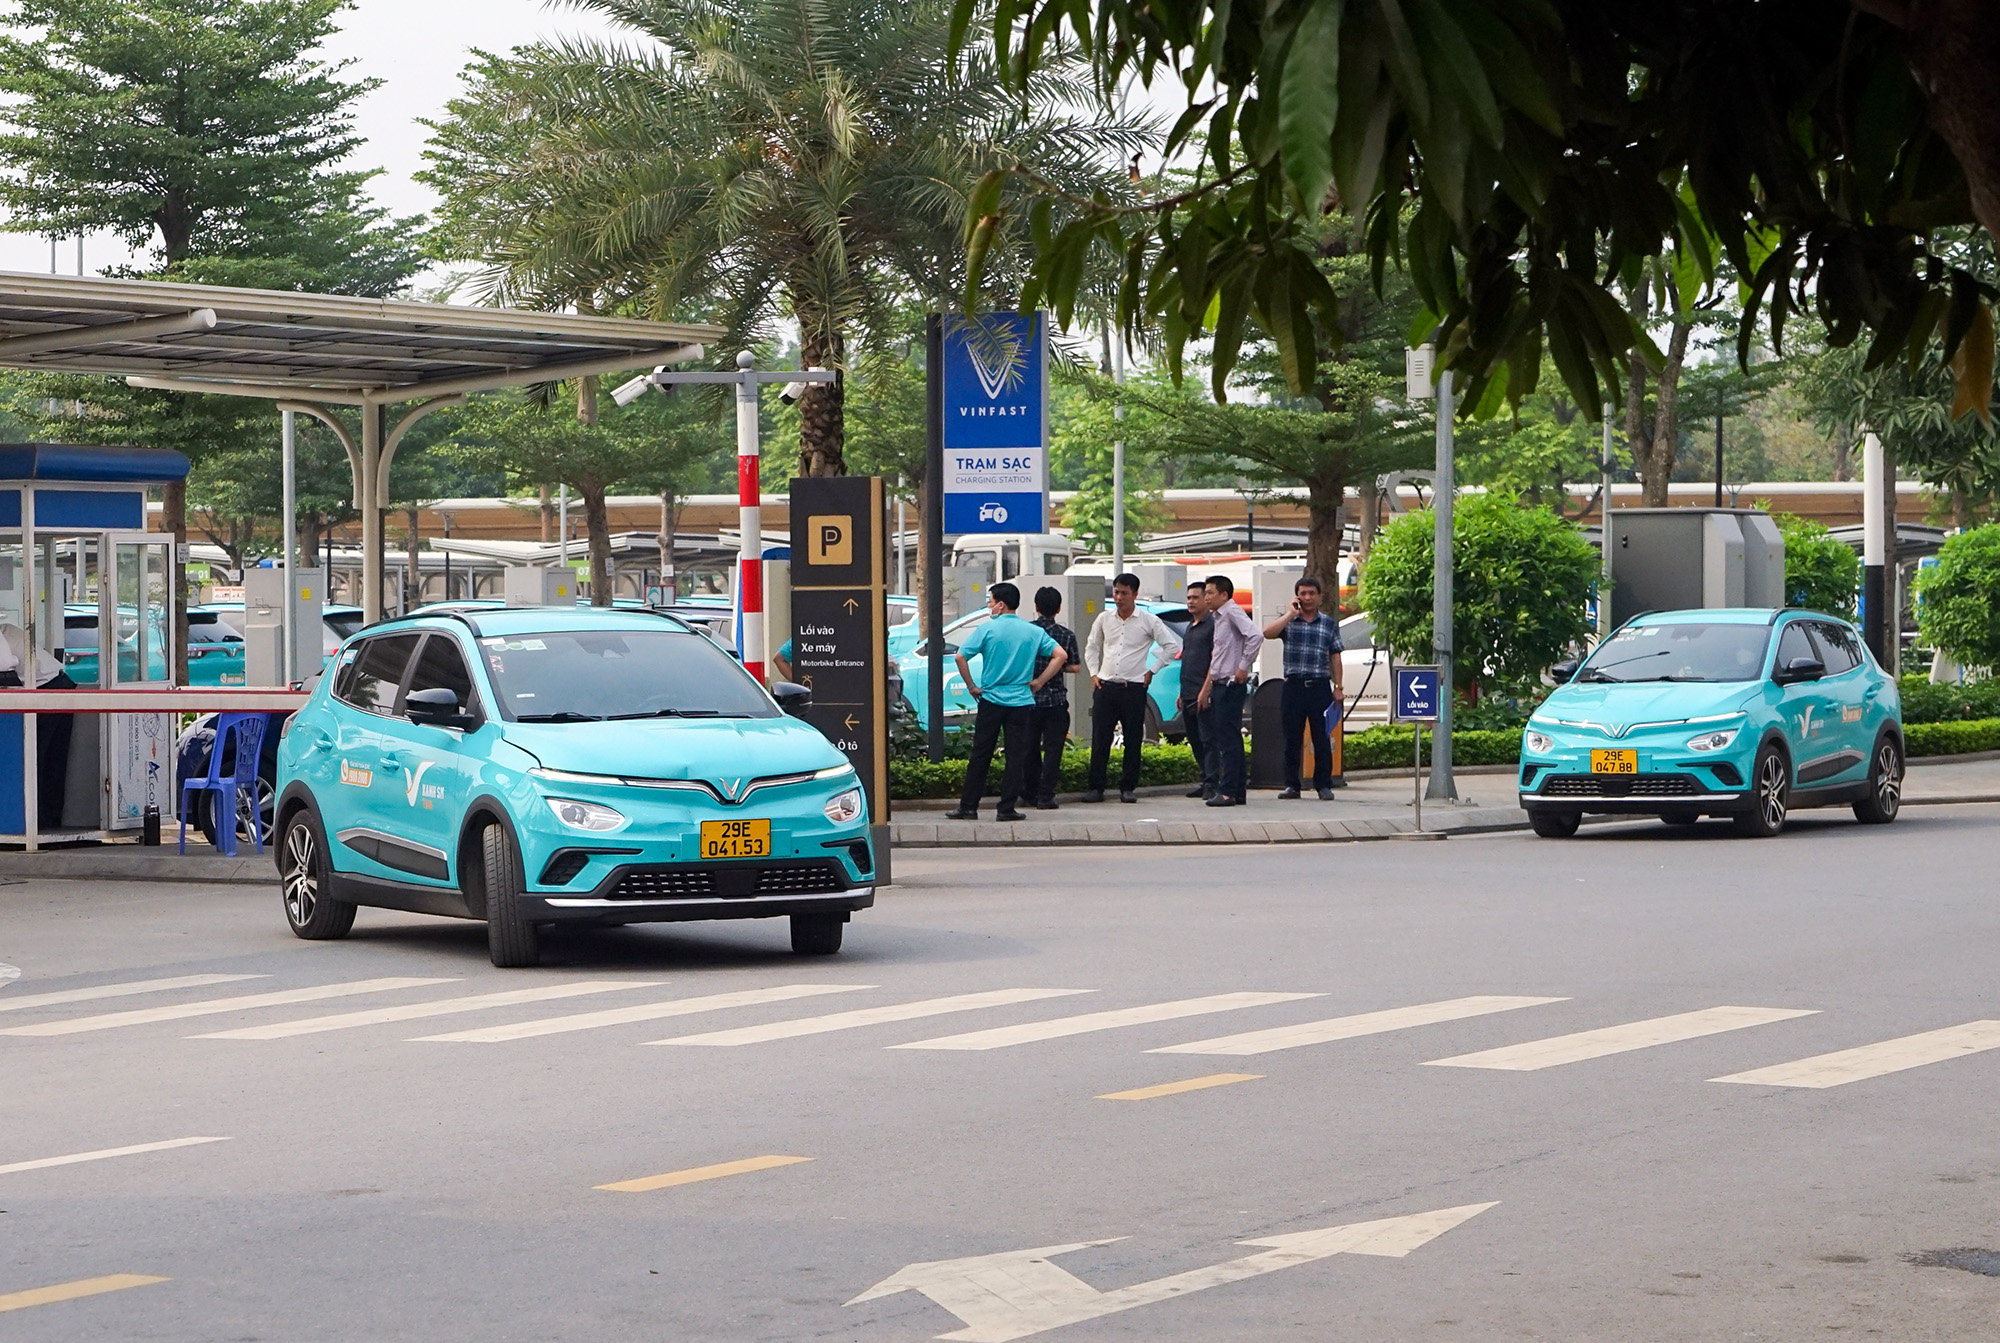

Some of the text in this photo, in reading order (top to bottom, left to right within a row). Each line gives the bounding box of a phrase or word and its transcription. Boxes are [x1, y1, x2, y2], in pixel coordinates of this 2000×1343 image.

[960, 406, 1026, 416] VINFAST
[956, 457, 1031, 472] TRẠM SẠC
[956, 475, 1031, 484] CHARGING STATION
[821, 526, 842, 556] P
[800, 624, 834, 635] Lối vào
[801, 643, 836, 654] Xe máy
[848, 741, 858, 750] tô
[1604, 751, 1624, 760] 29E
[1596, 762, 1632, 772] 047.88
[722, 822, 751, 838] 29E
[709, 839, 763, 856] 041.53
